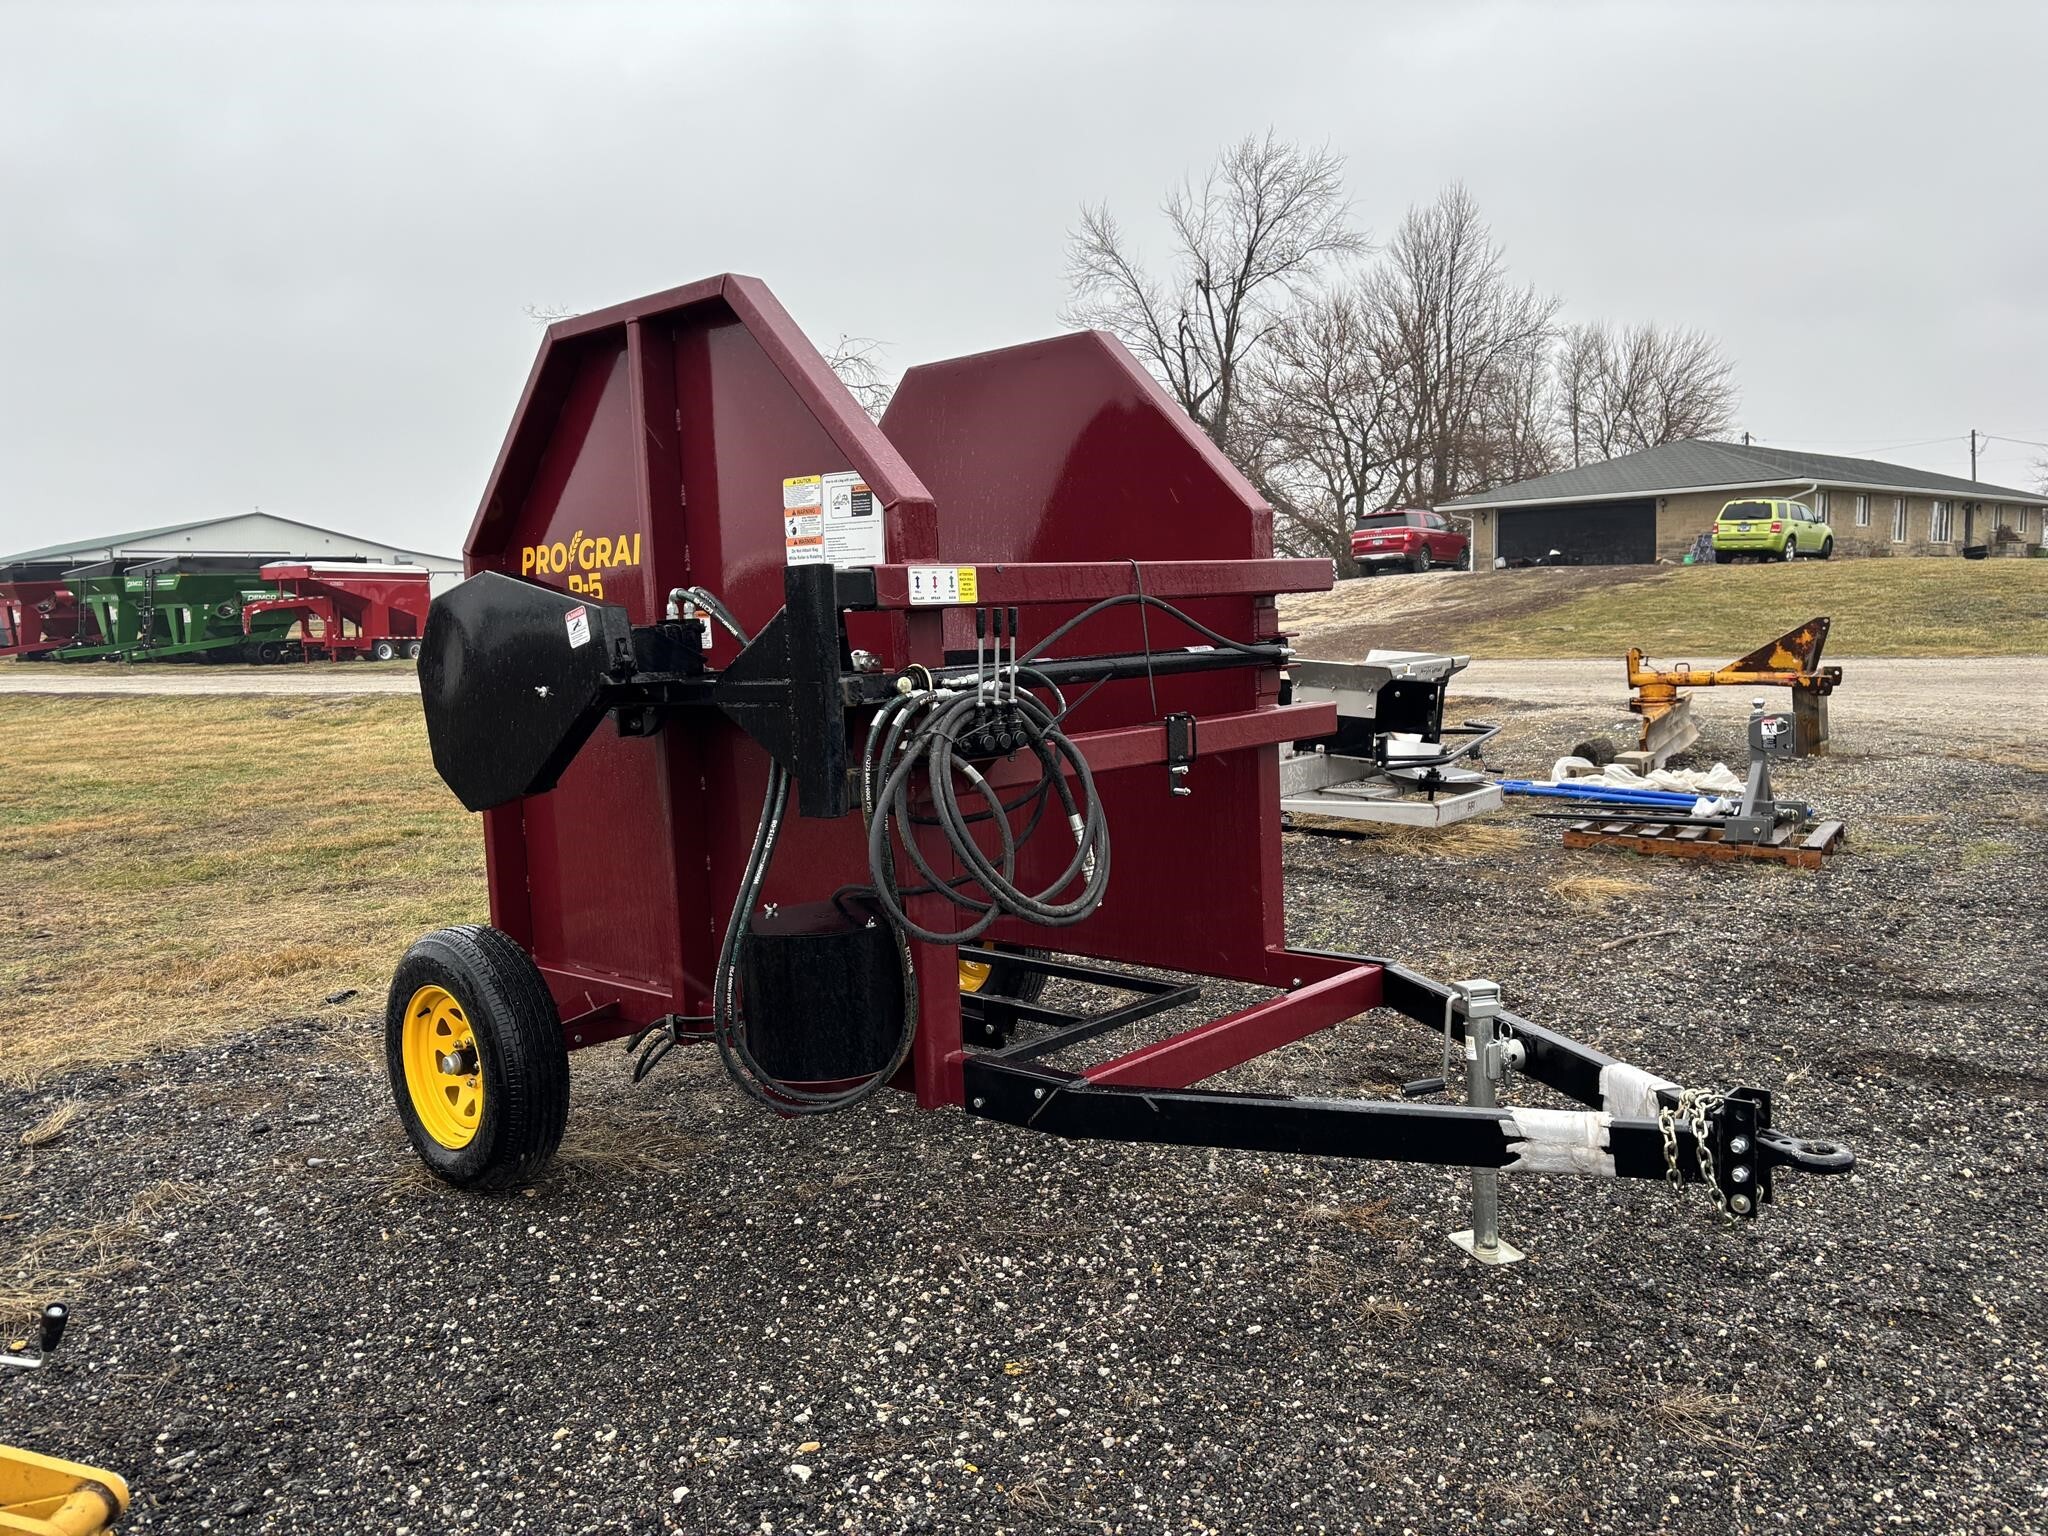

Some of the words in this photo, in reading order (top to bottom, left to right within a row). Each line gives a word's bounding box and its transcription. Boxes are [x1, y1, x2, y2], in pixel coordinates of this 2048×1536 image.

[796, 507, 816, 515] WARNING
[798, 537, 817, 545] WARNING
[522, 542, 567, 576] PRO
[578, 533, 641, 570] GRAI
